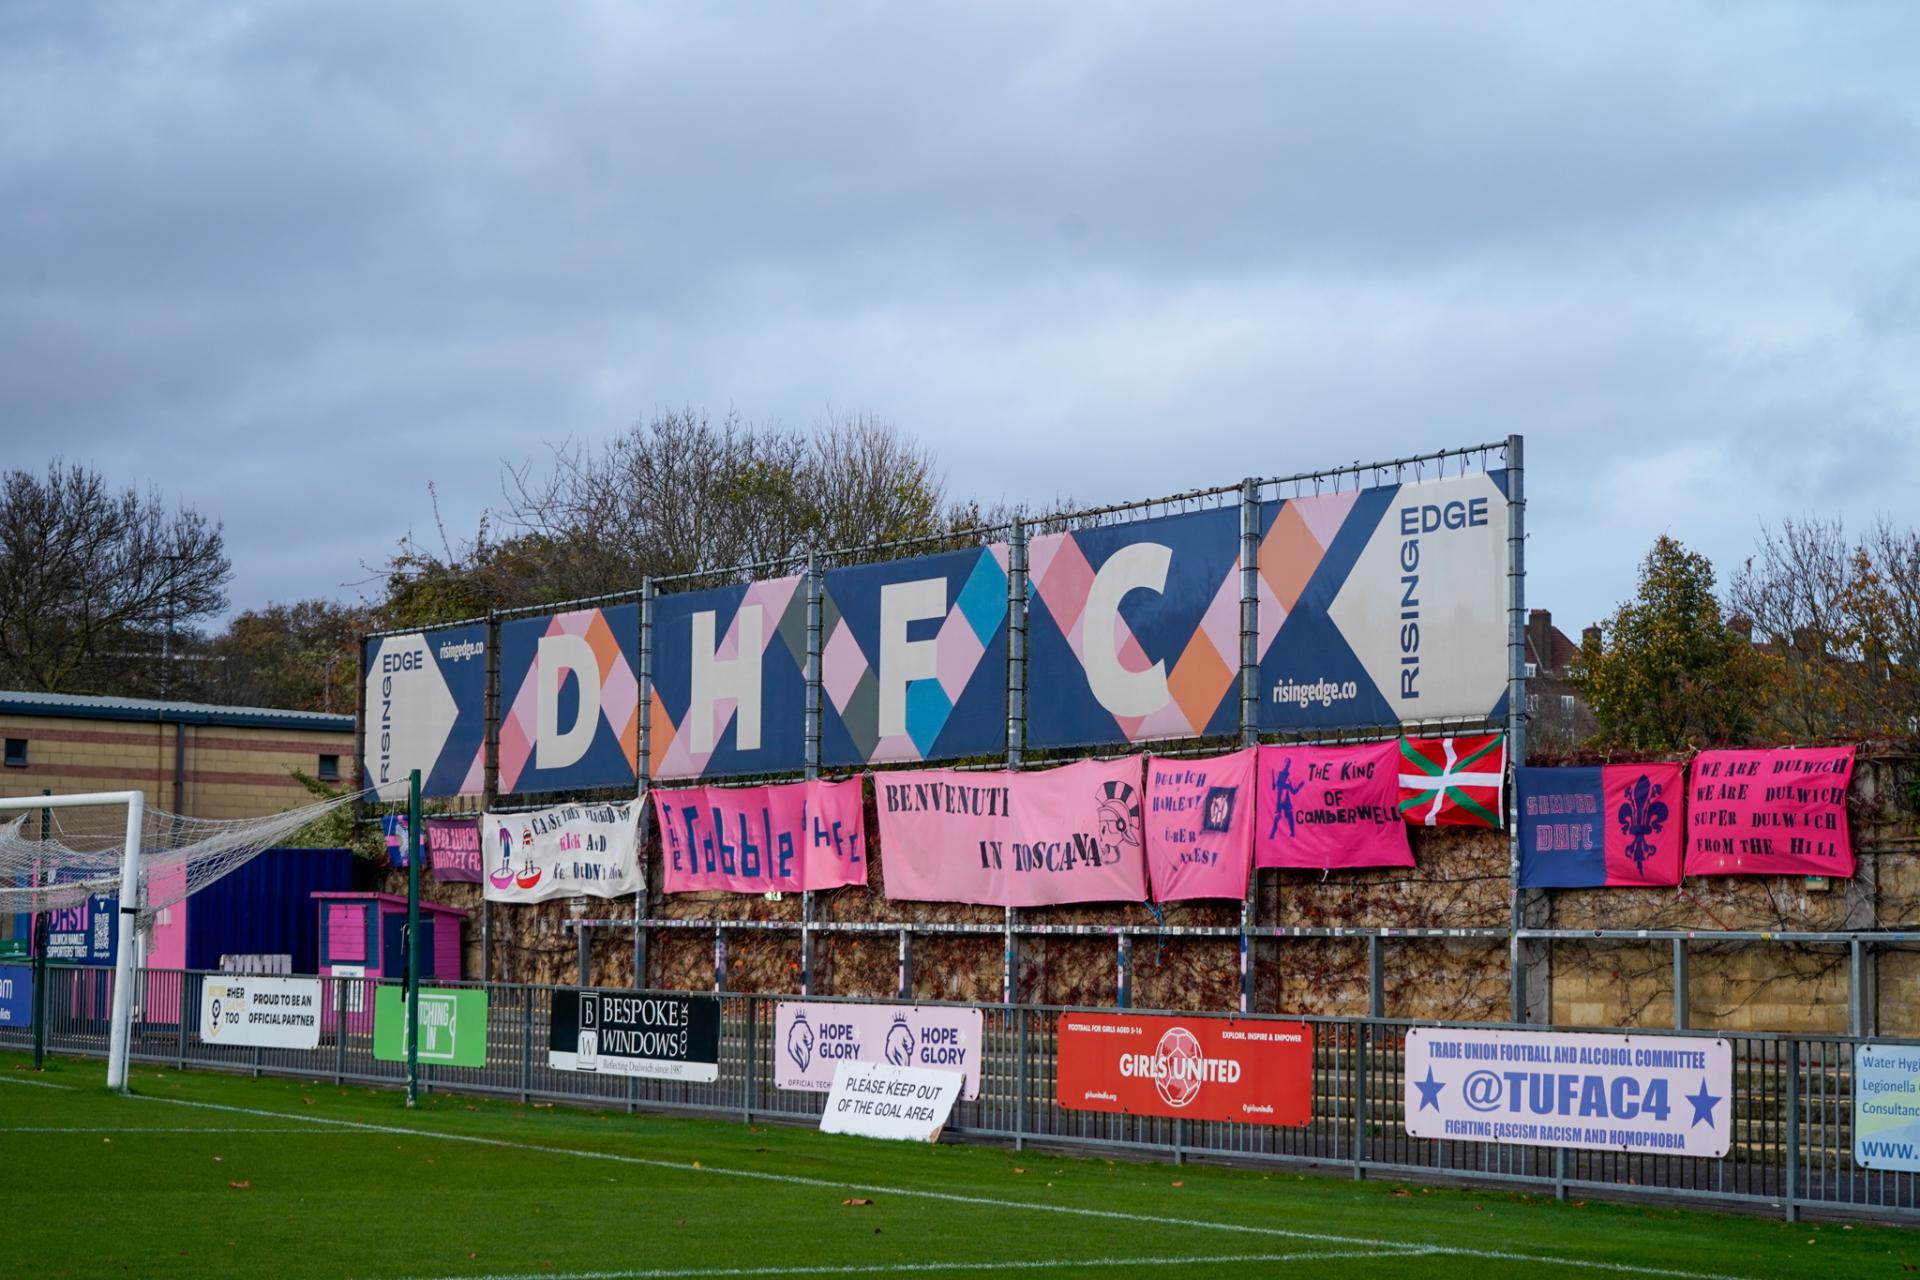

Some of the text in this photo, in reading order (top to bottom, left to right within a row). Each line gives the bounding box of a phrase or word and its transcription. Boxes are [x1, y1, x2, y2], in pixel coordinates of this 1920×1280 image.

[1400, 497, 1488, 535] EDGE
[1400, 539, 1420, 700] RISING
[383, 650, 423, 673] EDGE
[440, 639, 484, 663] risingedge.co
[1272, 677, 1357, 708] risingedge.co
[380, 675, 392, 784] RISING
[1308, 763, 1331, 781] THE
[1701, 758, 1848, 777] WE ARE DULWICH
[1155, 770, 1207, 788] DULWICH
[885, 782, 1010, 817] BENVENUTI
[1324, 791, 1344, 808] OF
[1696, 783, 1845, 805] WE ARE DULWICH
[1694, 809, 1837, 831] SUPER DULWICH
[428, 827, 479, 850] DULWICH
[1536, 823, 1594, 852] DHFC
[1696, 837, 1838, 857] FROM THE HILL
[433, 850, 481, 871] HAMLET FC
[978, 833, 1102, 872] IN TOSCANA
[226, 987, 245, 999] #HER
[253, 993, 312, 1006] PROUD TO BE AN
[225, 1012, 239, 1024] TOO
[248, 1013, 315, 1026] OFFICIAL PARTNER
[417, 1001, 449, 1026] ITCHING
[585, 1000, 594, 1024] B
[602, 998, 679, 1027] BESPOKE
[819, 1024, 854, 1041] HOPE
[921, 1027, 959, 1045] HOPE
[1067, 1023, 1091, 1032] FOOTBALL
[1091, 1024, 1101, 1032] FOR
[1102, 1025, 1115, 1033] GIRLS
[1116, 1026, 1130, 1034] AGED
[1247, 1032, 1267, 1041] INSPIRE
[1268, 1033, 1273, 1041] &
[1274, 1034, 1302, 1043] EMPOWER
[582, 1036, 594, 1056] W
[602, 1029, 679, 1057] WINDOWS
[819, 1042, 861, 1060] GLORY
[920, 1047, 967, 1065] GLORY
[1428, 1041, 1705, 1069] TRADE UNION FOOTBALL AND ALCOHOL COMMITTEE
[1862, 1055, 1896, 1069] Water
[629, 1061, 653, 1073] Dulwich
[654, 1064, 669, 1075] since
[1119, 1053, 1241, 1083] GIRLS UNITED
[788, 1079, 815, 1089] OFFICIAL
[845, 1077, 885, 1095] PLEASE
[886, 1081, 916, 1097] KEEP
[916, 1085, 943, 1100] OUT
[1462, 1069, 1671, 1121] @TUFAC4
[1862, 1079, 1916, 1094] Legionella
[837, 1099, 935, 1122] OF THE GOAL AREA
[1445, 1119, 1685, 1149] FIGHTING FASCISM RACISM AND HOMOPHOBIA
